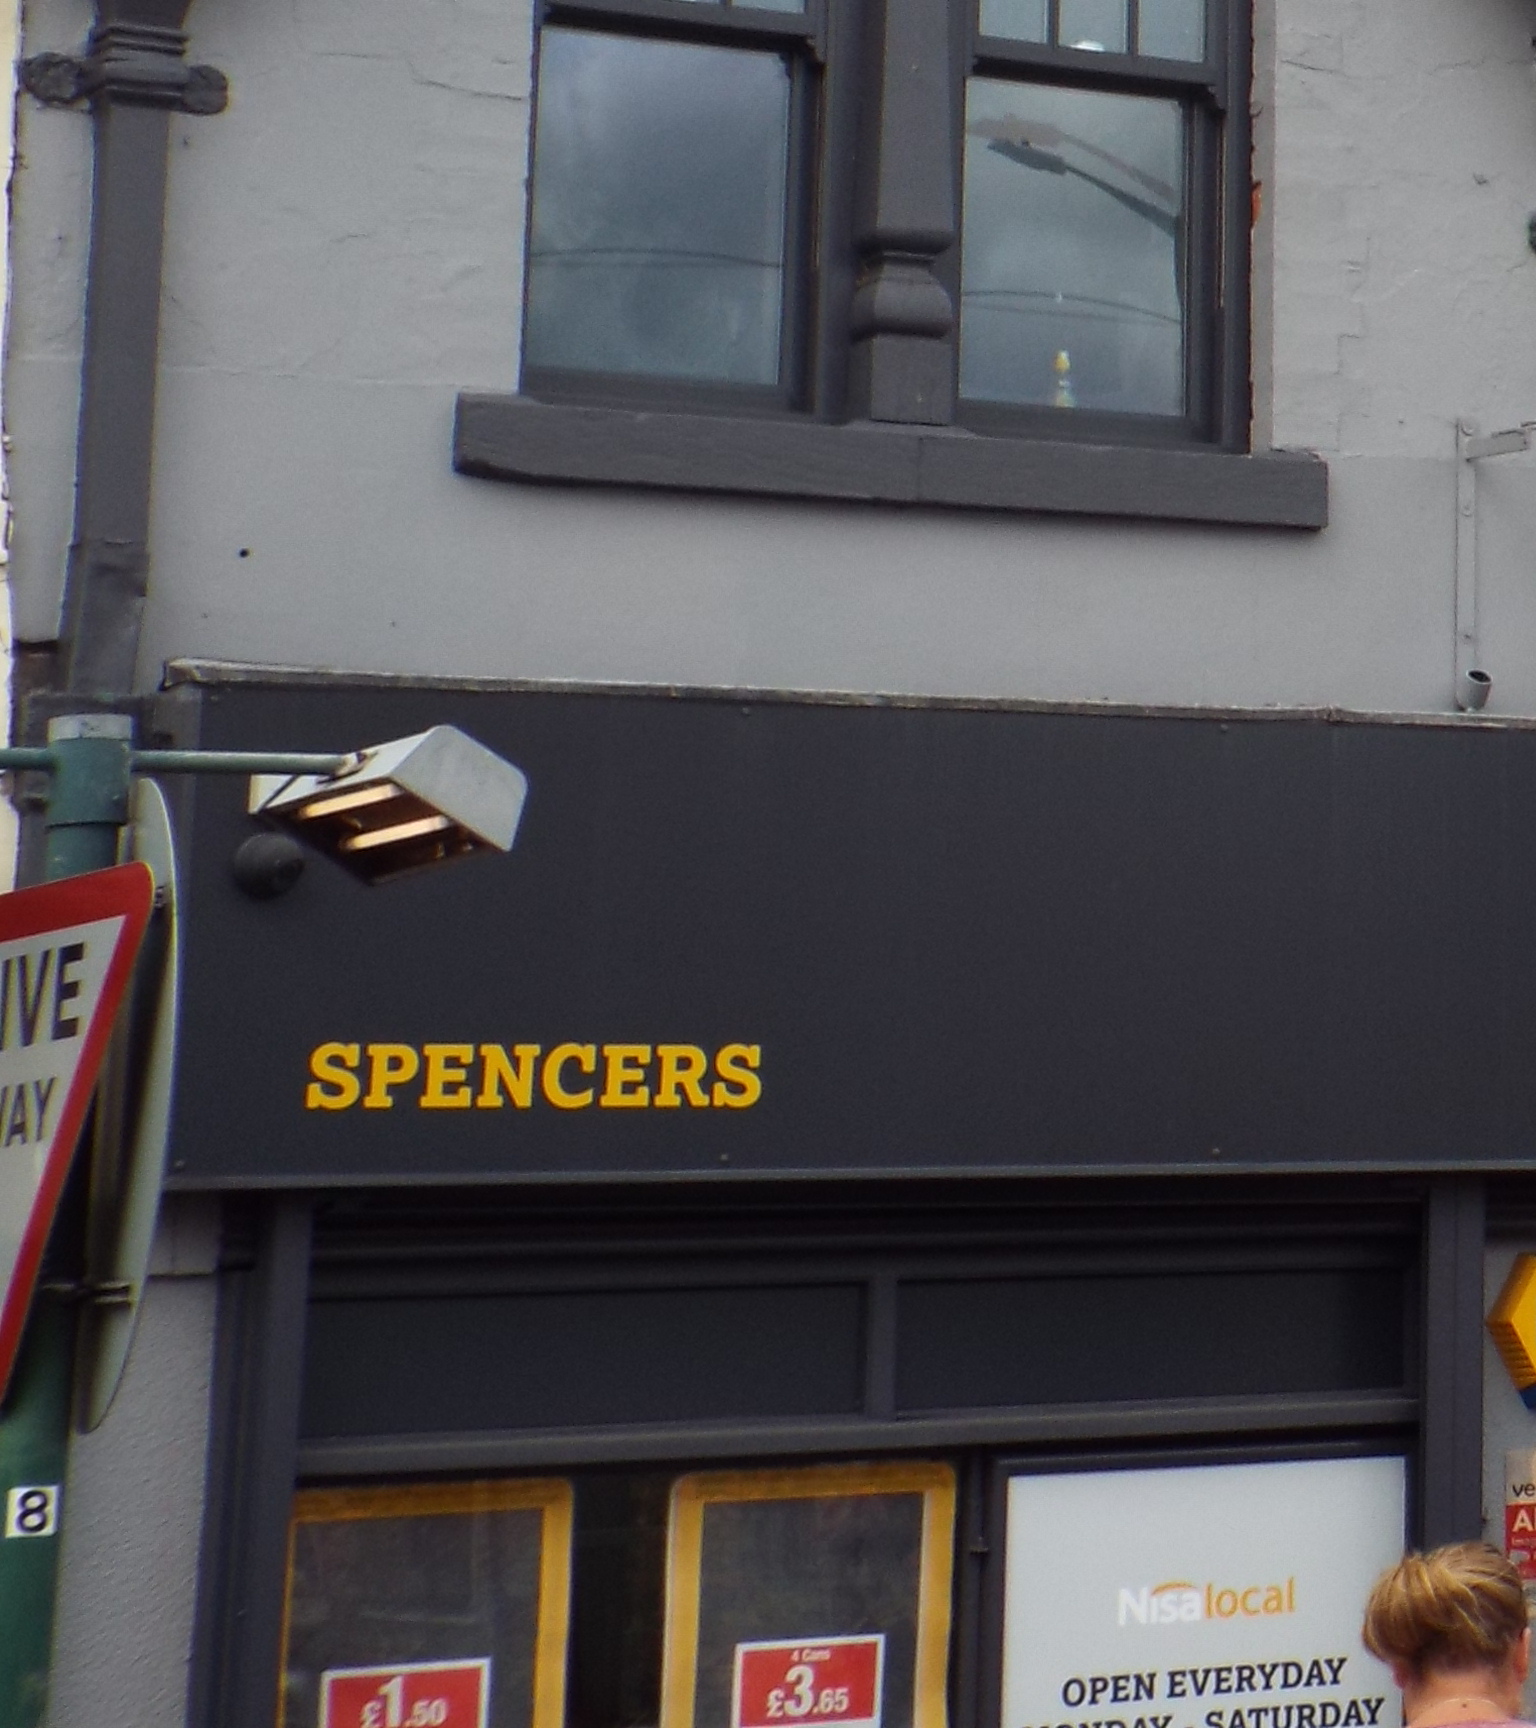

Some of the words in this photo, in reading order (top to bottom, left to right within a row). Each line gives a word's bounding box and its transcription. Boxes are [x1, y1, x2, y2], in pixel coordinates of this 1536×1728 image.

[305, 1041, 764, 1110] SPENCERS
[16, 1490, 48, 1534] 8
[767, 1664, 849, 1718] £3.65
[1062, 1672, 1156, 1707] OPEN
[1167, 1657, 1348, 1699] EVERYDAY
[1205, 1698, 1386, 1728] SATURDAY
